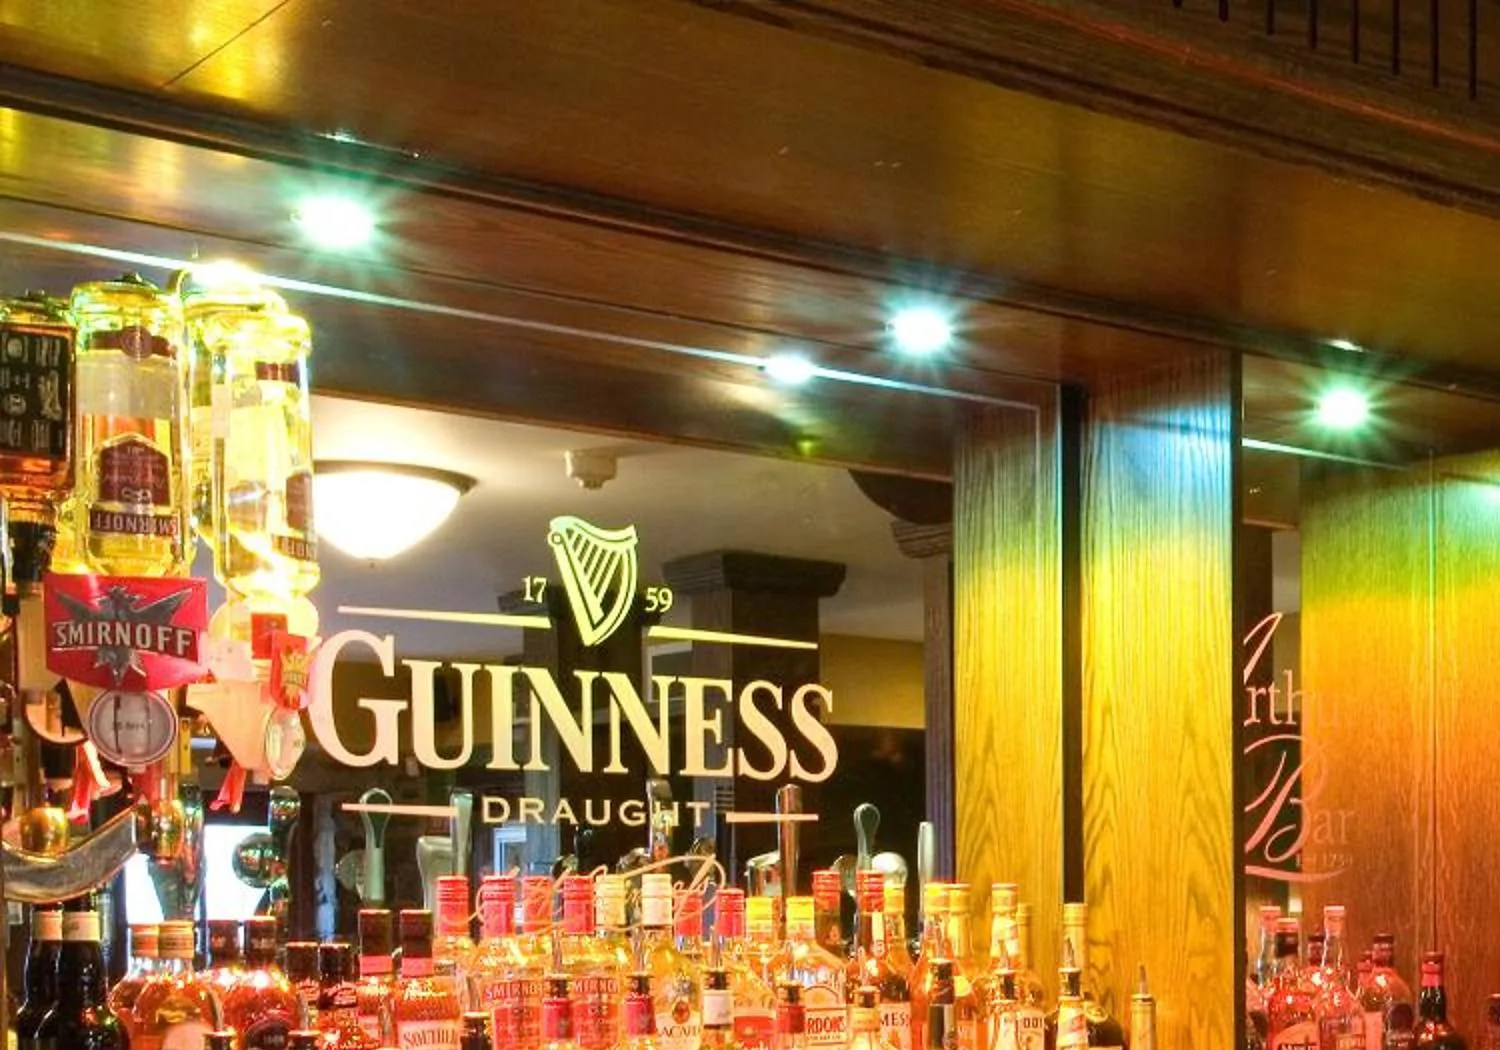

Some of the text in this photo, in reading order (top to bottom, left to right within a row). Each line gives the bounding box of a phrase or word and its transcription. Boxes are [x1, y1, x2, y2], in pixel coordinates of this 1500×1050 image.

[522, 575, 674, 613] 17 59
[55, 620, 194, 657] SMIRNOFF
[307, 628, 839, 784] GUINNESS
[480, 795, 711, 828] DRAUGHT
